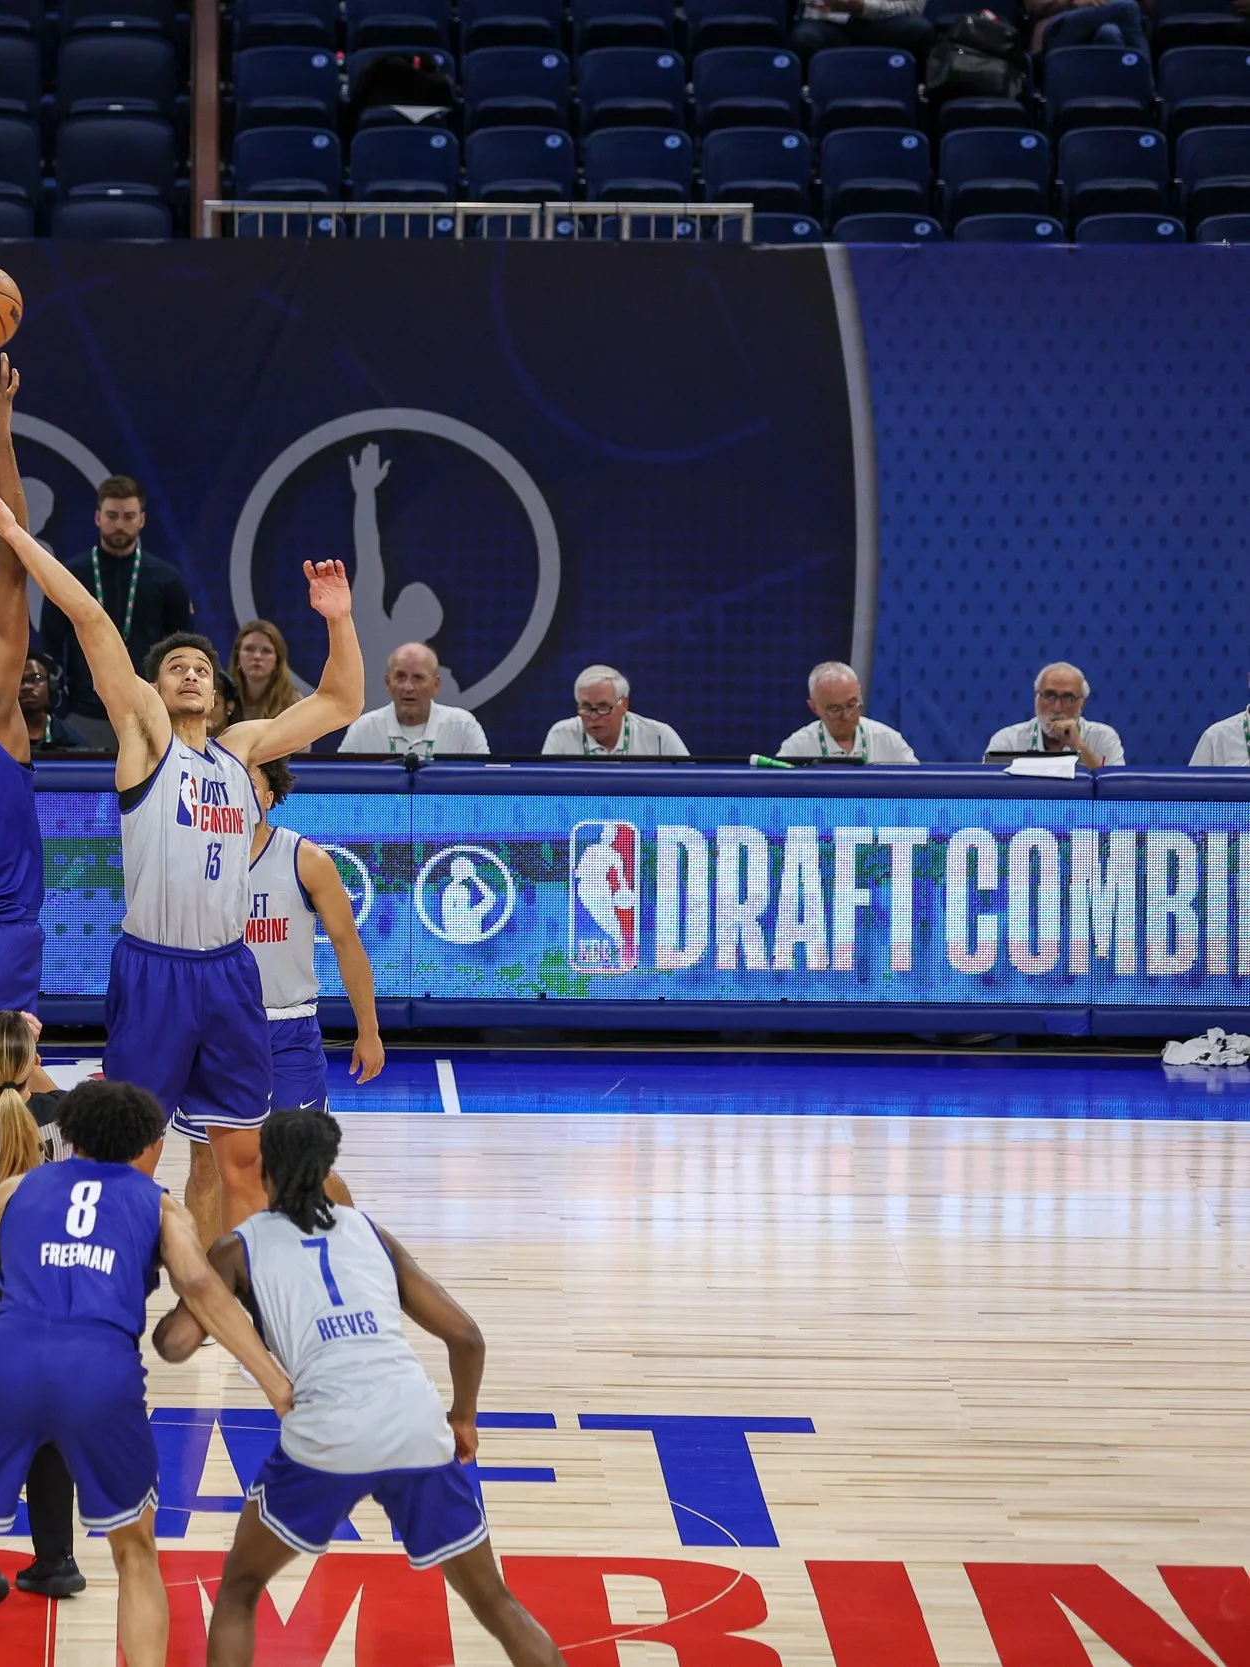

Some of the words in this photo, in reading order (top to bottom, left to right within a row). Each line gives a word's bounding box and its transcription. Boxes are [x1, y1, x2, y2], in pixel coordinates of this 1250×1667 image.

[205, 842, 222, 881] 13
[656, 824, 930, 971] DRAFT
[946, 827, 1250, 975] COMBI
[66, 1180, 102, 1239] 8
[40, 1242, 116, 1275] FREEMAN
[300, 1237, 344, 1307] 7
[316, 1310, 378, 1342] REEVES
